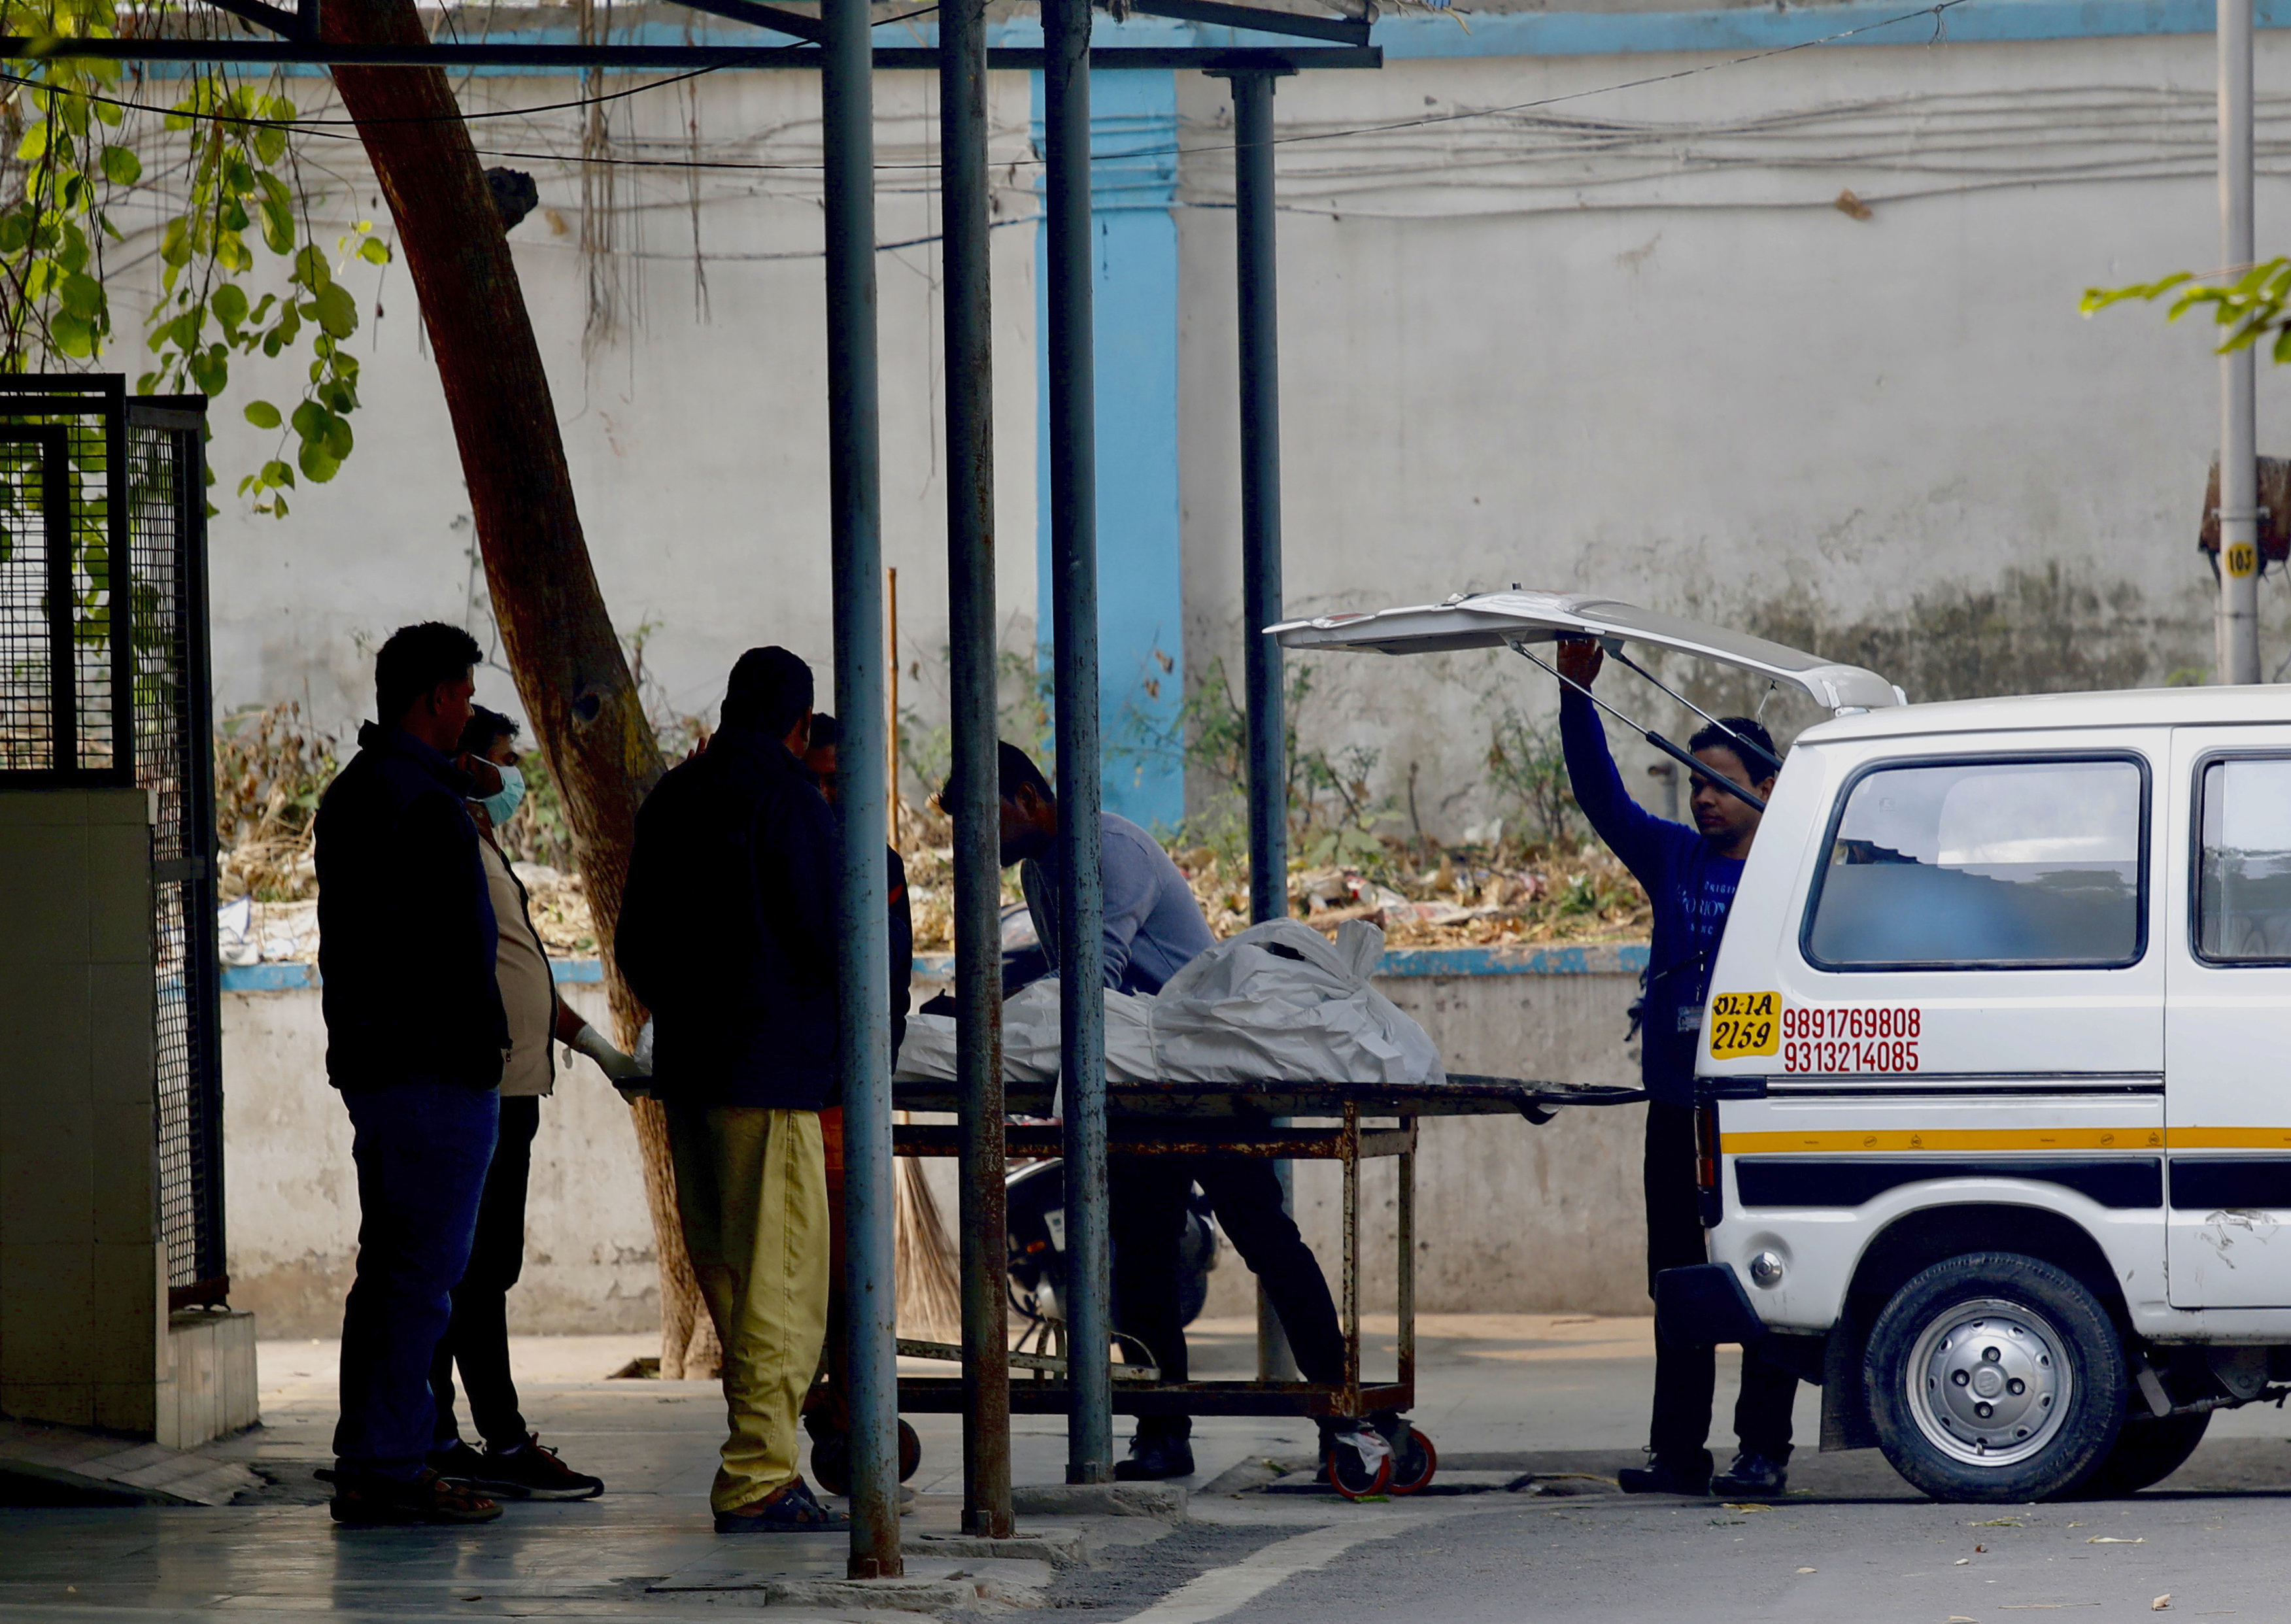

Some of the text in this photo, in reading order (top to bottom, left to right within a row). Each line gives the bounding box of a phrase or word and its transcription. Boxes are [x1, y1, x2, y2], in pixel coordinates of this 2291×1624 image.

[1712, 1020, 1771, 1050] 2159
[1783, 1008, 1921, 1039] 9891769808
[1784, 1041, 1919, 1072] 9313214085
